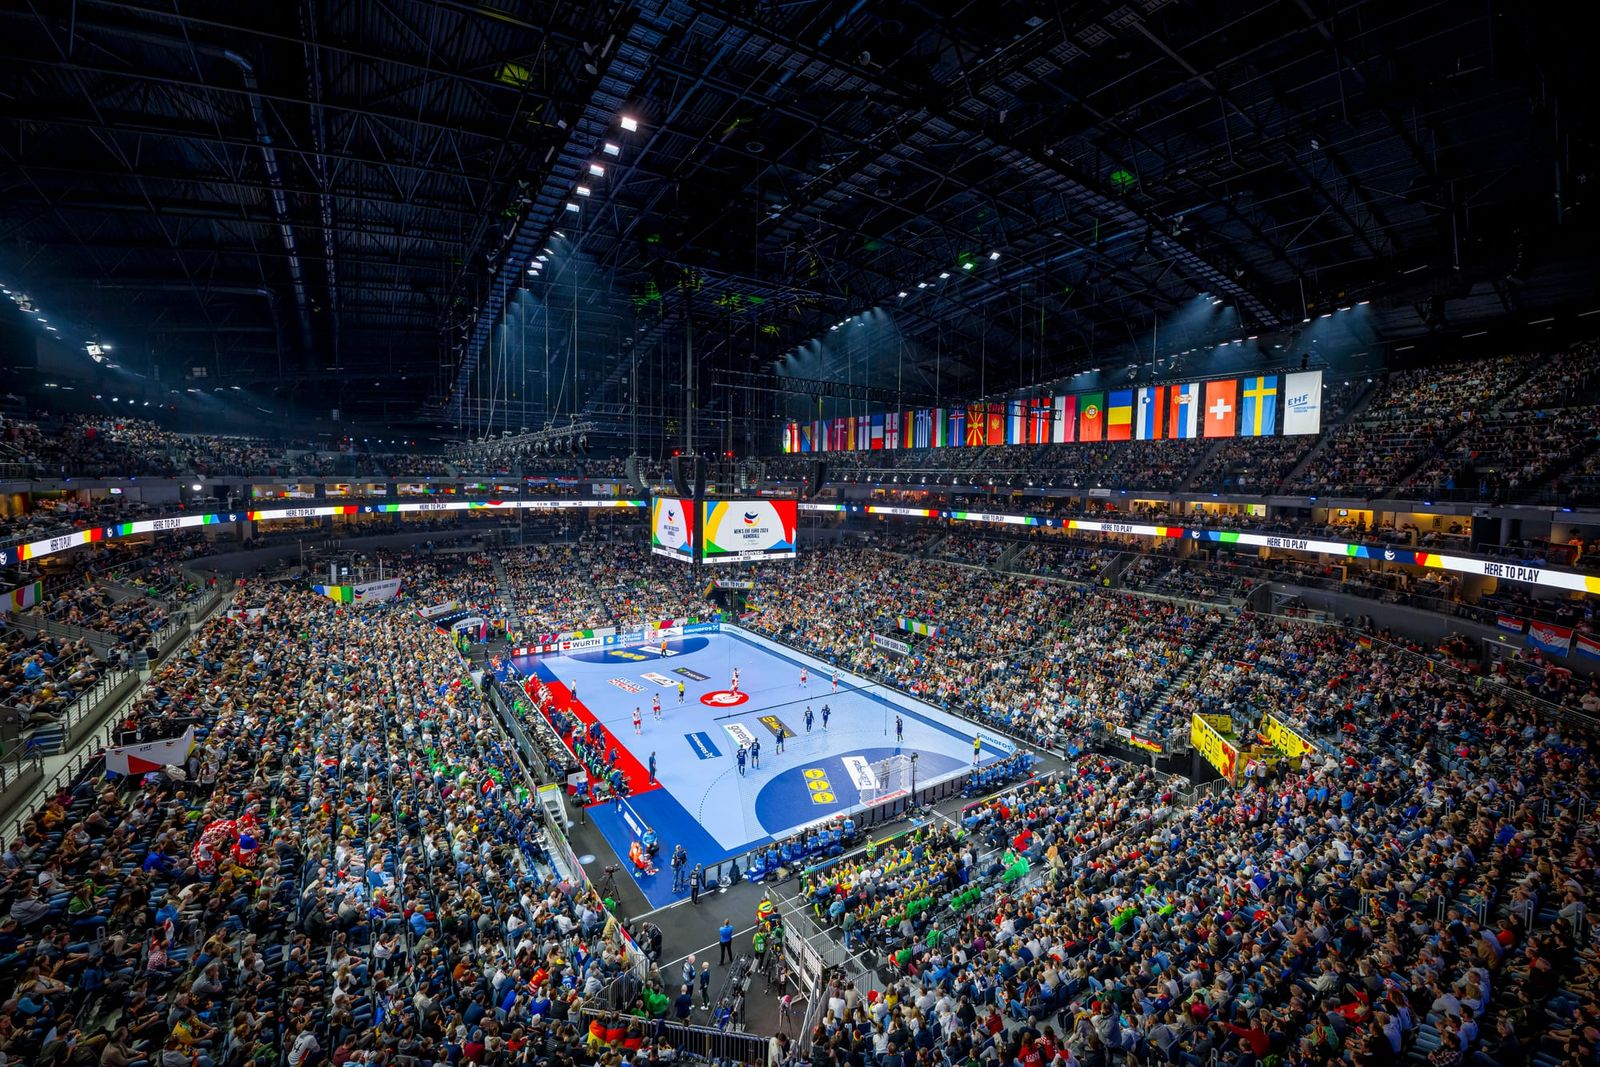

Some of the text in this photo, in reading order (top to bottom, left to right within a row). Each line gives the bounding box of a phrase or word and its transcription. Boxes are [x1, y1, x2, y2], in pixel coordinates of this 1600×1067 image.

[1288, 394, 1308, 405] EHF
[286, 509, 297, 517] HERE
[153, 518, 180, 530] HERE TO PLAY
[50, 540, 58, 550] HERE
[59, 538, 64, 549] TO
[1266, 538, 1308, 550] HERE TO PLAY
[1484, 562, 1540, 582] HERE TO PLAY
[728, 725, 751, 746] gorenje
